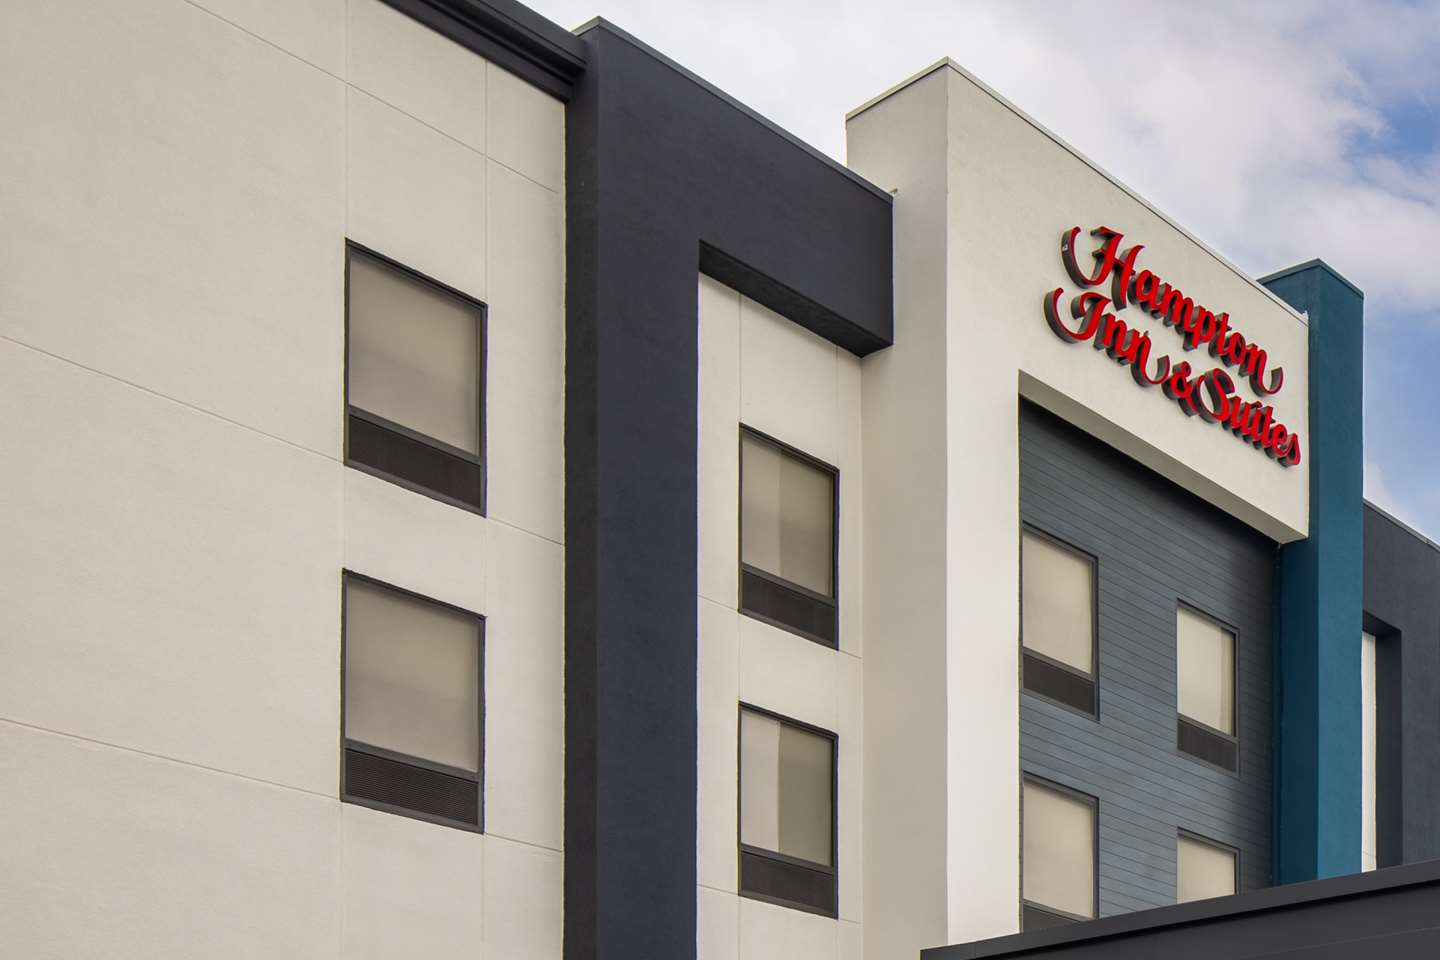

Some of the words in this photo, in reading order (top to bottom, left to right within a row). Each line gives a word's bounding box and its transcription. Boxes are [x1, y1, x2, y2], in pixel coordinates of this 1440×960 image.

[1044, 287, 1170, 388] Inn
[1192, 368, 1301, 468] Suites
[1061, 226, 1283, 397] Hampton
